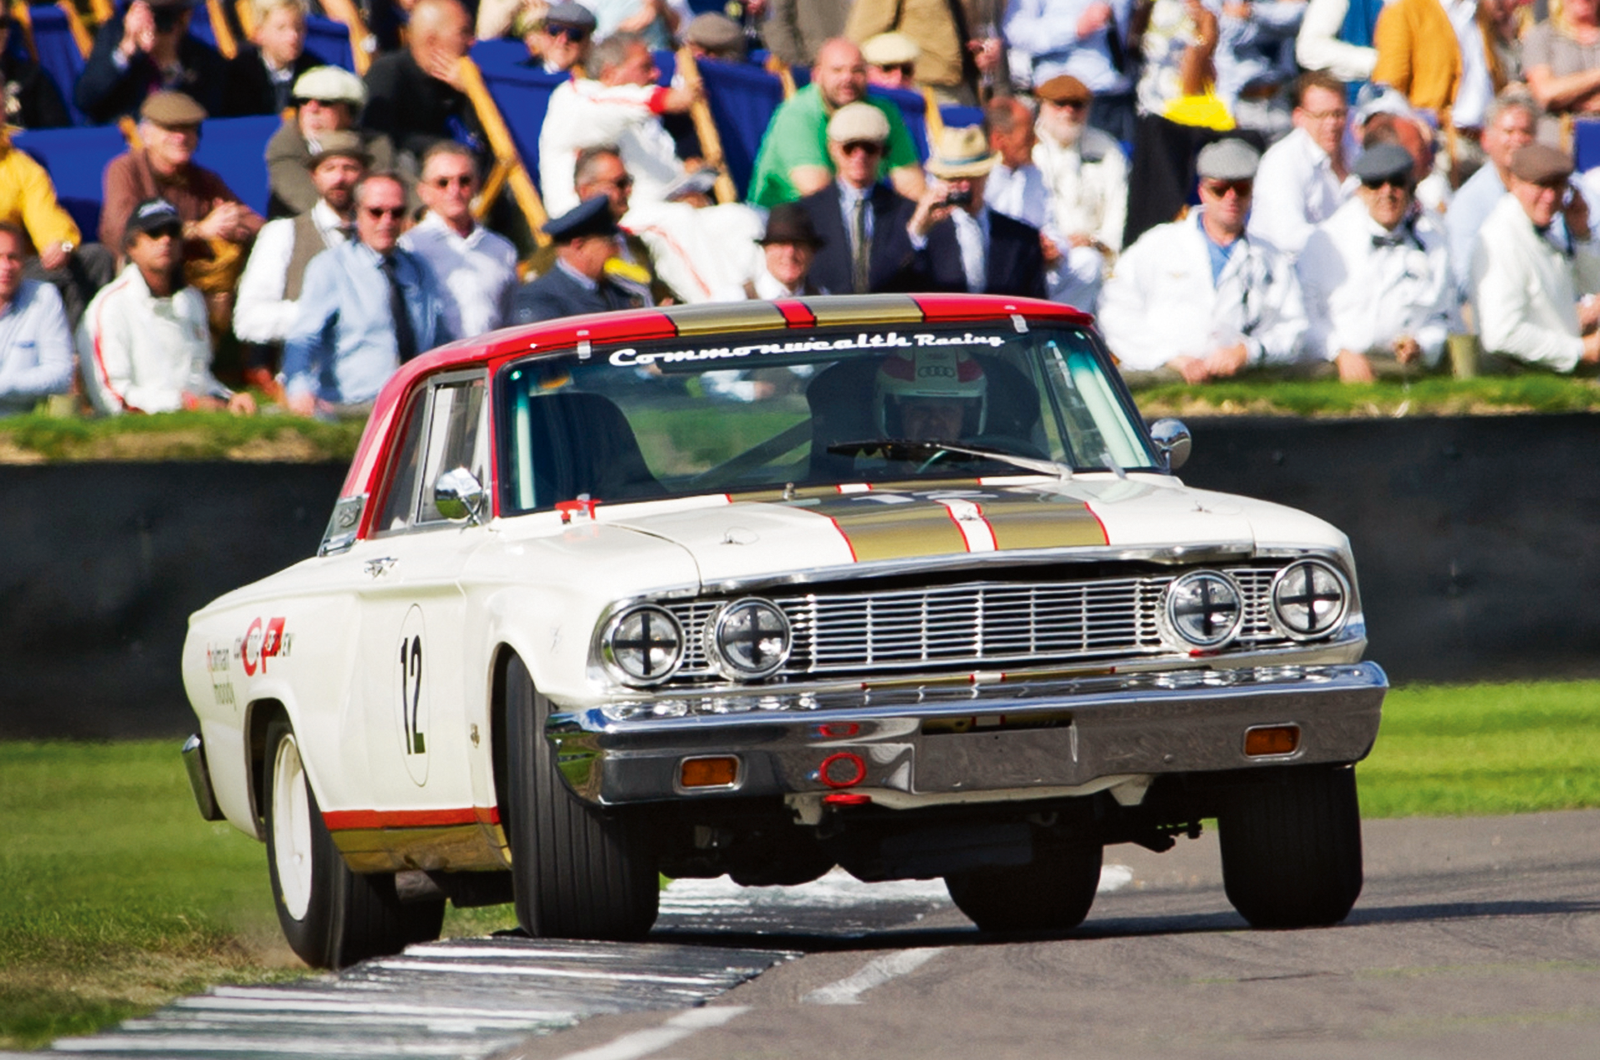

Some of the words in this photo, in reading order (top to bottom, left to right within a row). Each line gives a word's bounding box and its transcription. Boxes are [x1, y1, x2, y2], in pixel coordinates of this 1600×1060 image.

[609, 333, 912, 366] Commonwealth
[913, 333, 1005, 347] Racing
[400, 635, 426, 755] 12
